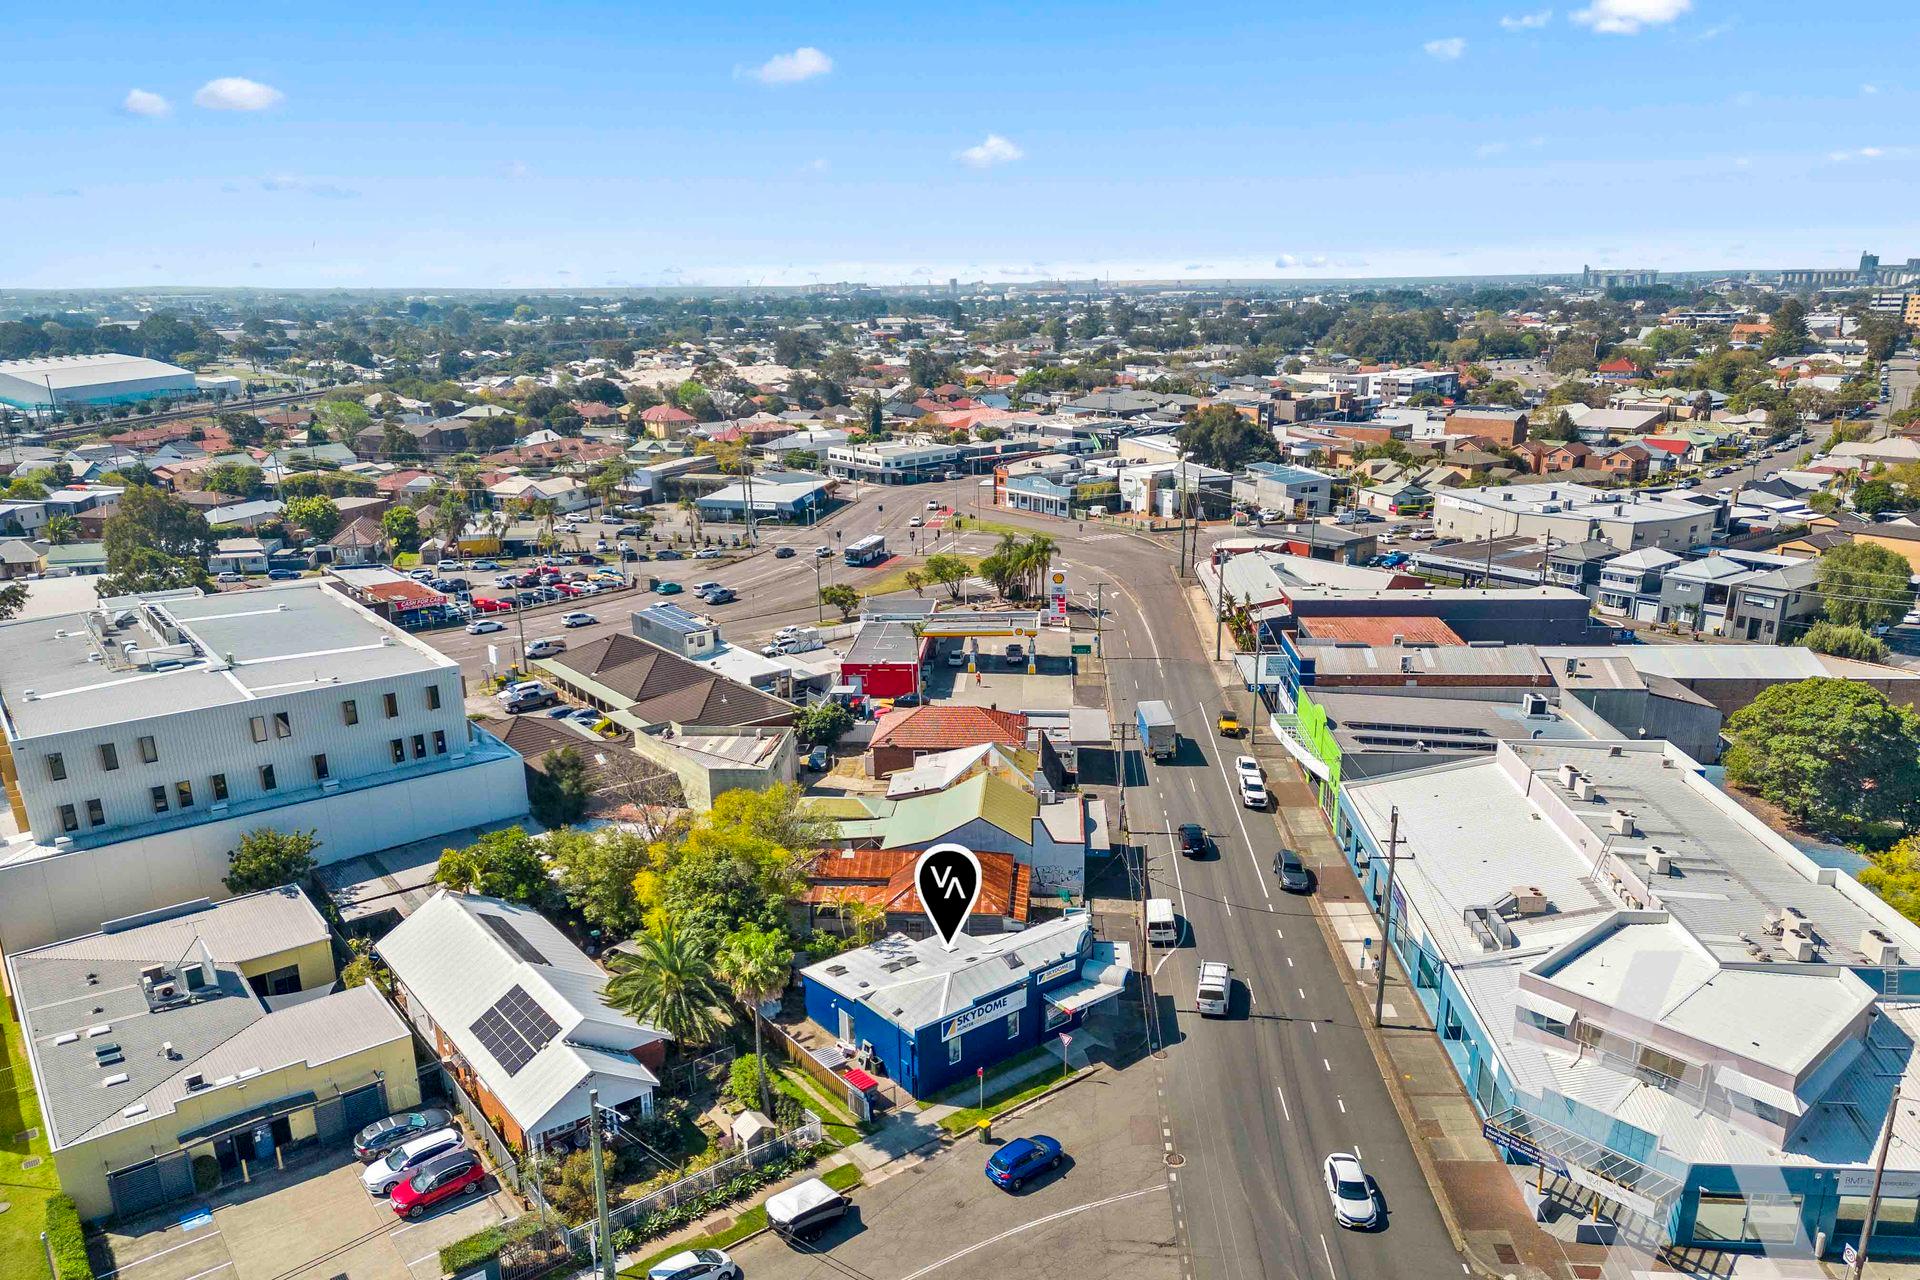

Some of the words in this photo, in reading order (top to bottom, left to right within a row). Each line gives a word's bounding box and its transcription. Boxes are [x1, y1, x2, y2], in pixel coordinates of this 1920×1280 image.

[957, 997, 1008, 1026] SKYDOME
[1485, 1132, 1498, 1141] from
[1498, 1138, 1510, 1148] your
[1510, 1144, 1539, 1160] investment
[1486, 1127, 1511, 1142] Maximise
[1510, 1139, 1520, 1147] the
[1520, 1144, 1534, 1154] cash
[1845, 1176, 1865, 1185] BMT
